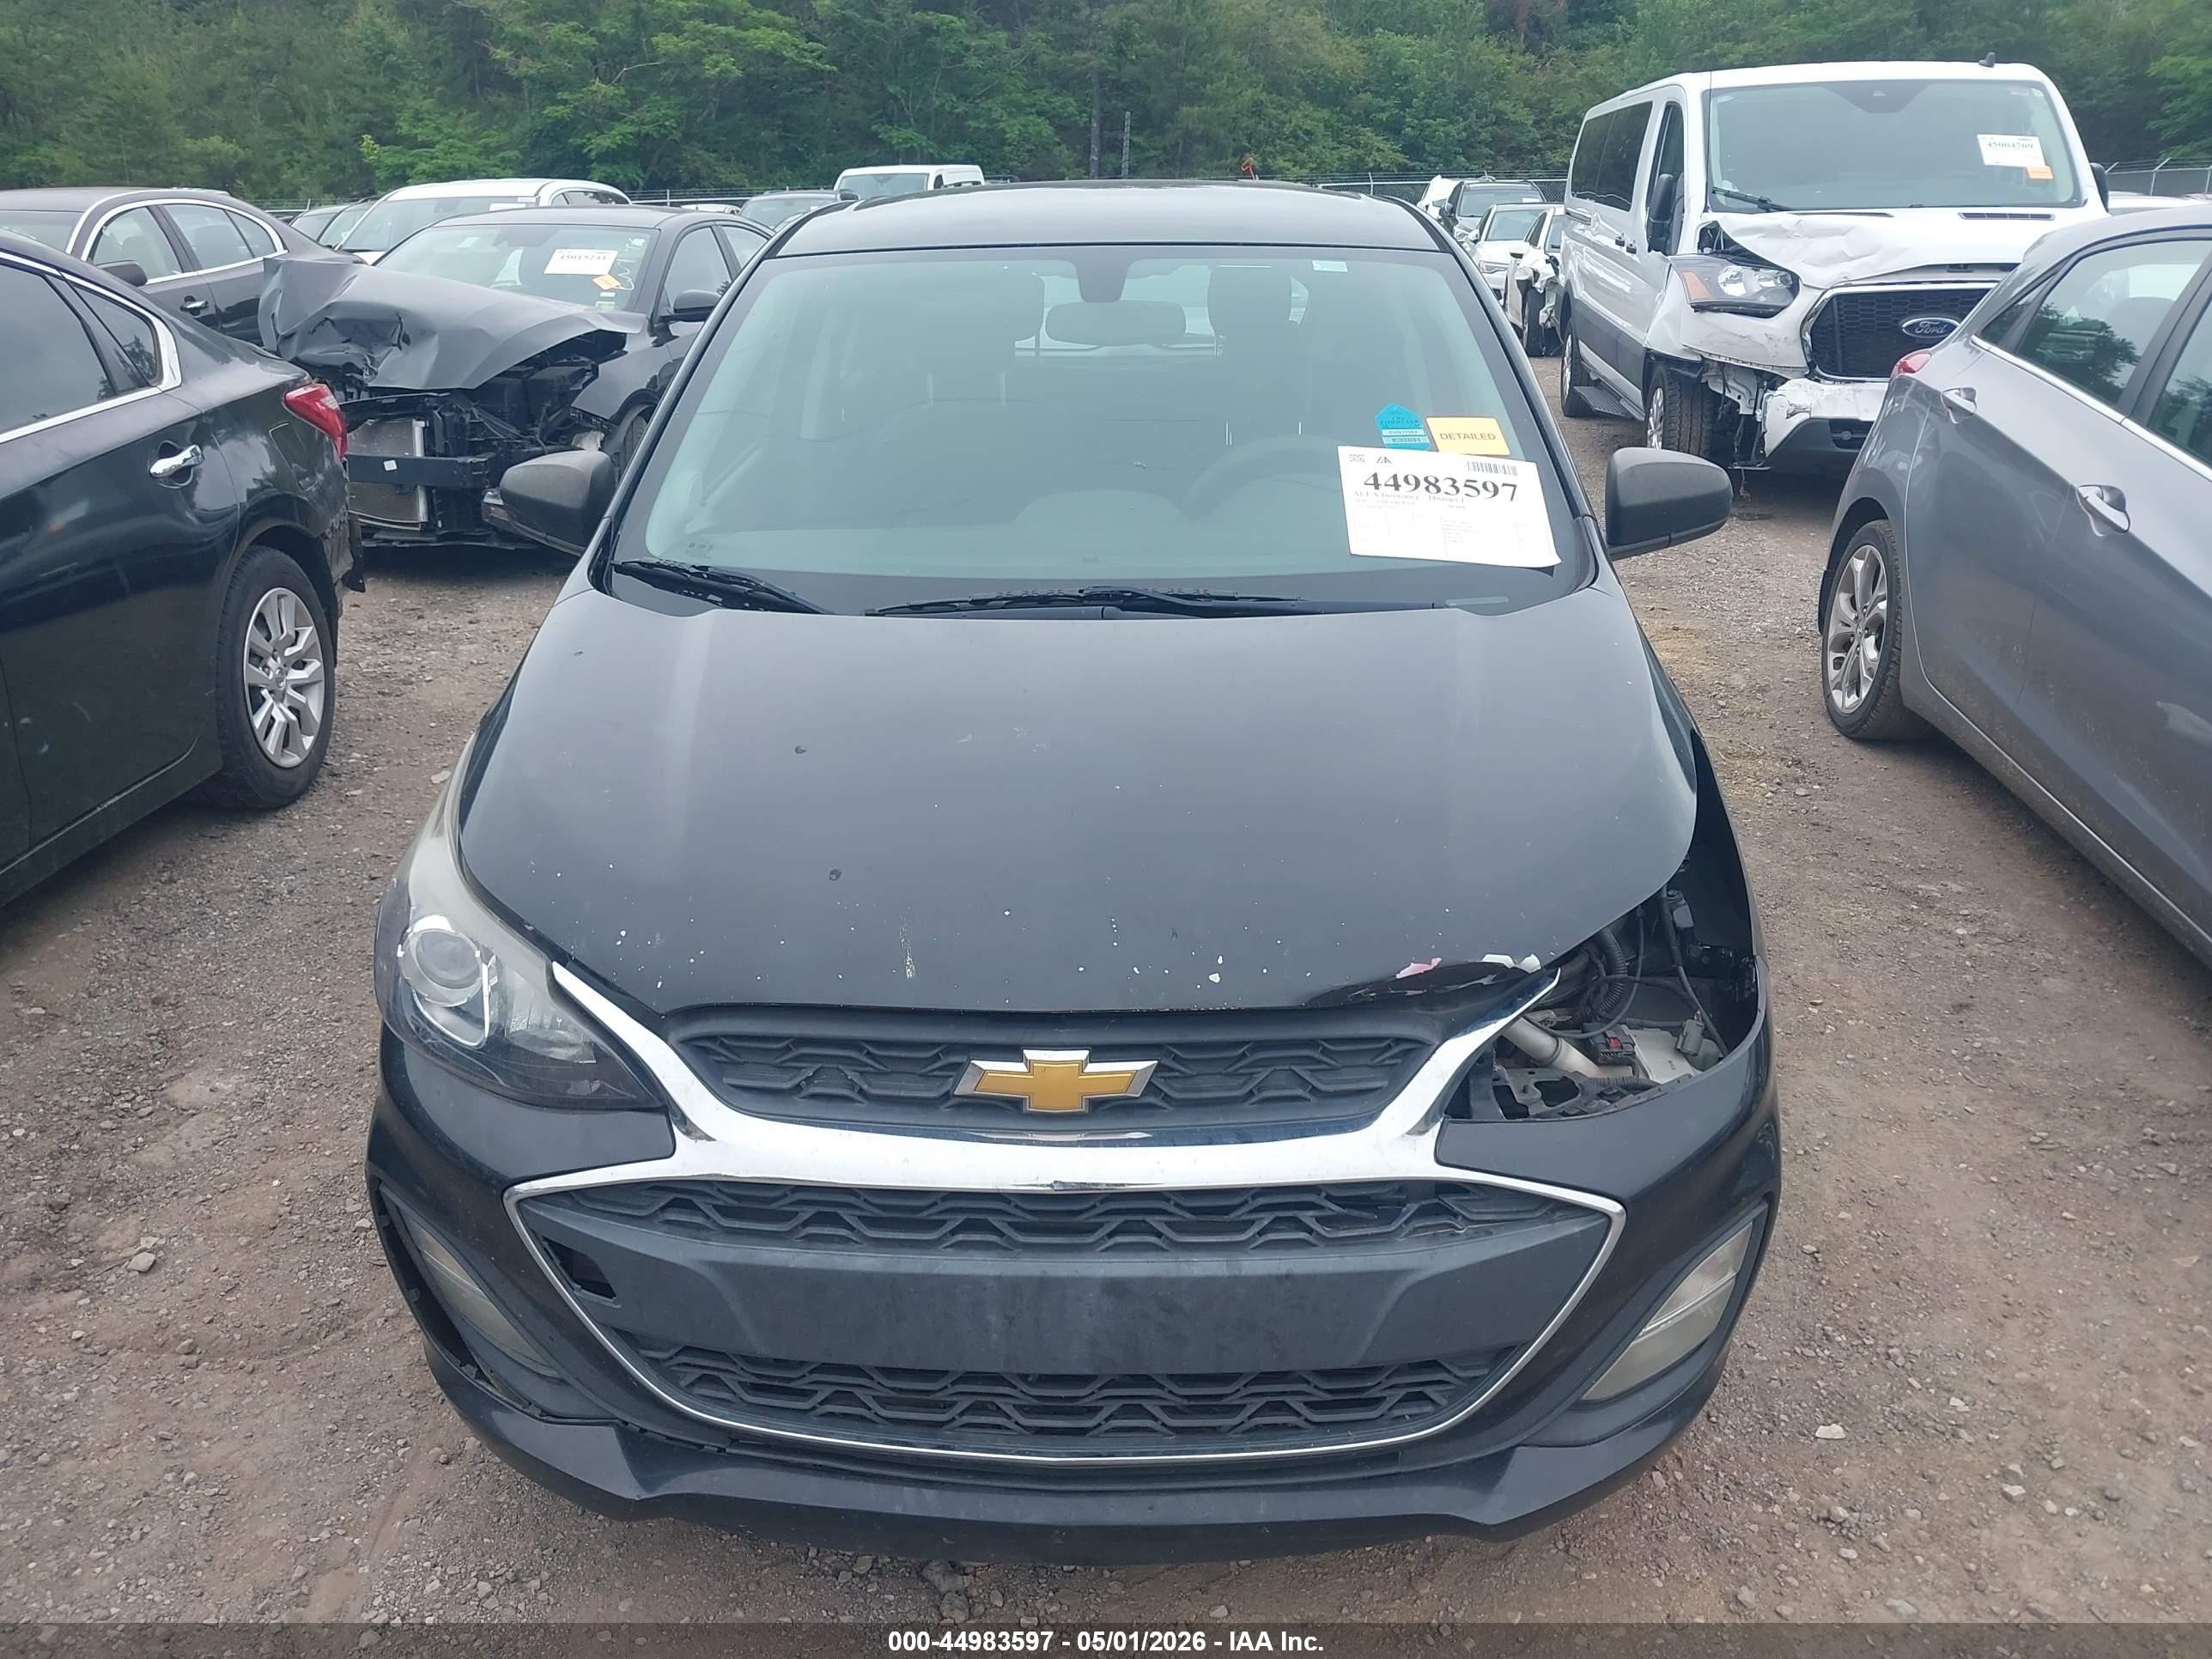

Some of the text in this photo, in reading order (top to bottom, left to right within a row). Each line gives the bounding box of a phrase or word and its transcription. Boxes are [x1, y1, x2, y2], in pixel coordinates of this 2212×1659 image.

[1915, 321, 1948, 335] Ford
[1440, 432, 1496, 441] DETAILED
[1364, 471, 1517, 502] 44983597
